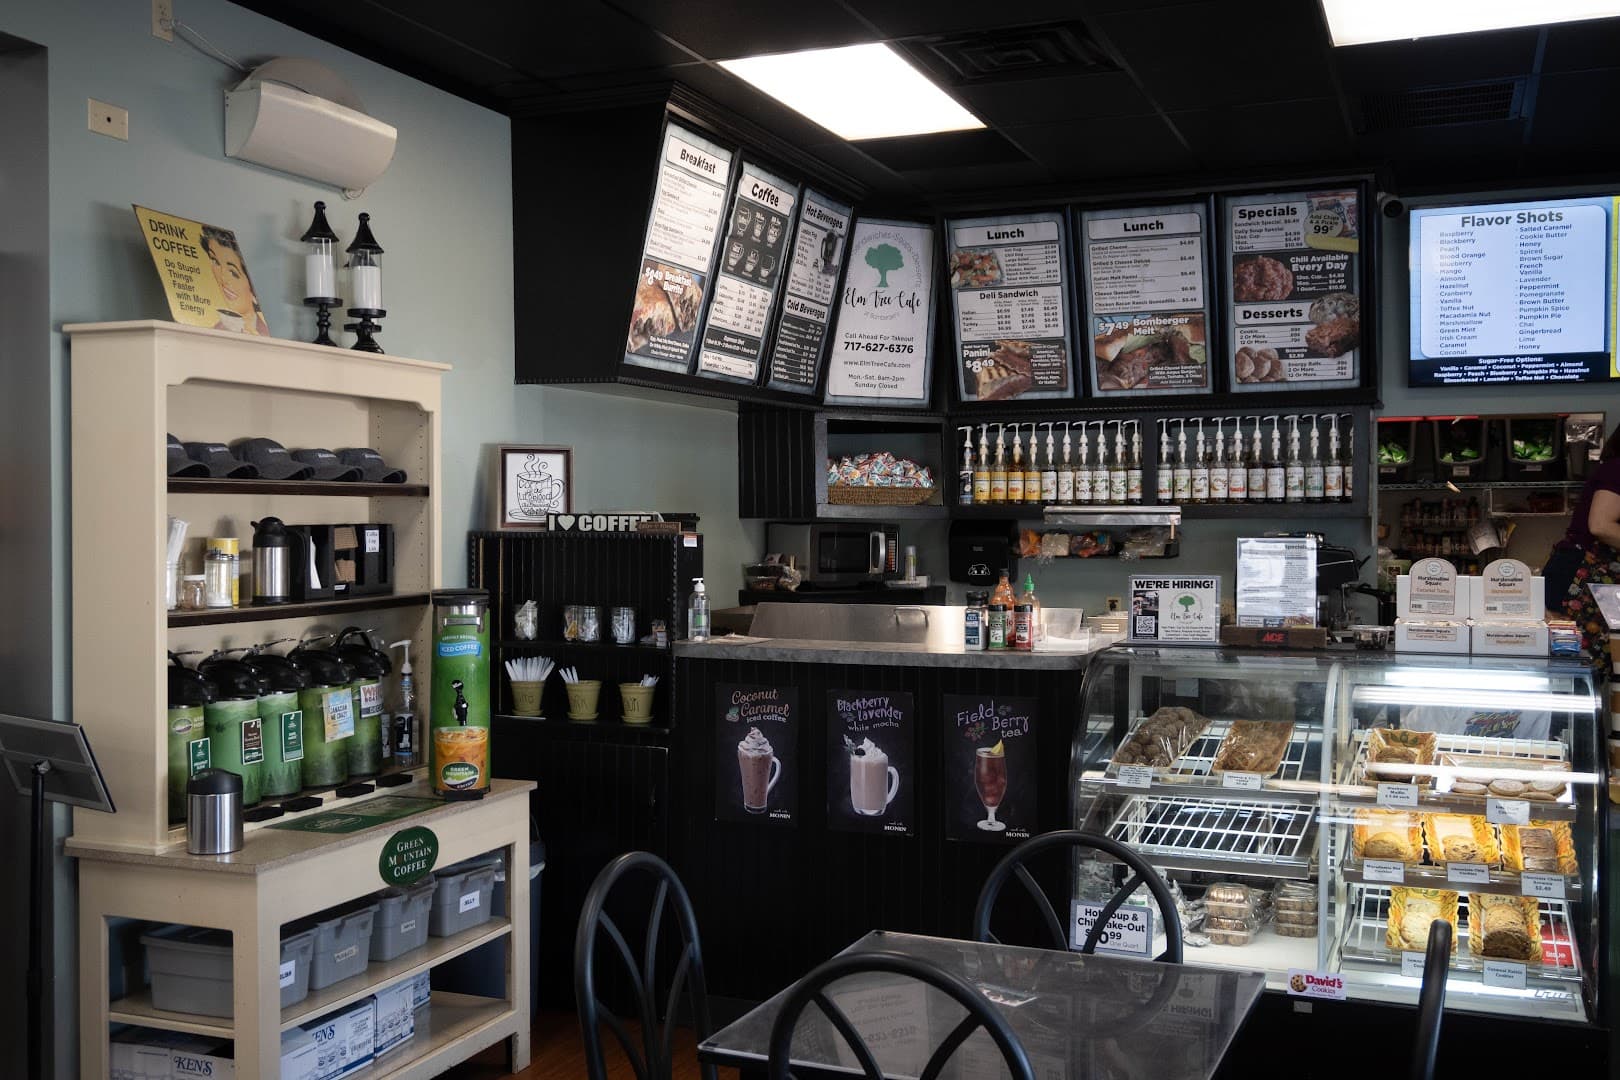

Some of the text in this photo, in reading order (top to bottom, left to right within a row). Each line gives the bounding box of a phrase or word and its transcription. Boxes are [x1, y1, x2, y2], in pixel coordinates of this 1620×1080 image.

[680, 149, 716, 174] Breakfast
[751, 183, 780, 208] Coffee
[806, 204, 843, 230] Hot Beverages
[1238, 206, 1298, 220] Specials
[1461, 210, 1564, 228] Flavor Shots
[148, 219, 189, 240] DRINK
[1124, 220, 1164, 232] Lunch
[987, 228, 1025, 240] Lunch
[152, 237, 200, 260] COFFEE
[1290, 254, 1349, 263] Chili Available
[164, 258, 200, 275] Do Stupid
[1292, 262, 1347, 272] Every Day
[168, 270, 194, 283] Things
[172, 280, 196, 292] Faster
[1520, 283, 1560, 291] Peppermint
[176, 292, 211, 306] with More
[845, 287, 922, 314] Elm Tree Cafe
[980, 289, 1039, 300] Deli Sandwich
[180, 302, 205, 316] Energy
[786, 299, 826, 320] Cold Beverages
[1242, 308, 1303, 320] Desserts
[1133, 316, 1190, 327] Bomberger
[1133, 328, 1156, 336] Melt
[844, 342, 914, 354] 717-627-6376
[549, 514, 556, 531] I
[1134, 580, 1214, 589] WE'RE HIRING!
[454, 644, 478, 652] COFFEE
[732, 688, 778, 705] Coconut
[740, 702, 790, 718] Caramel
[838, 696, 890, 712] Blackberry
[746, 714, 787, 724] iced coffee
[957, 700, 994, 727] Field
[848, 718, 900, 732] white mocha
[992, 716, 1029, 732] Berry
[1001, 728, 1022, 738] tea
[397, 837, 424, 852] GREEN
[394, 859, 427, 878] COFFEE
[1110, 912, 1130, 922] oup
[1132, 913, 1139, 922] &
[1106, 921, 1146, 932] ake-Out
[1305, 974, 1342, 988] David's
[1312, 986, 1336, 994] Cookies
[174, 1056, 214, 1076] KEN'S
